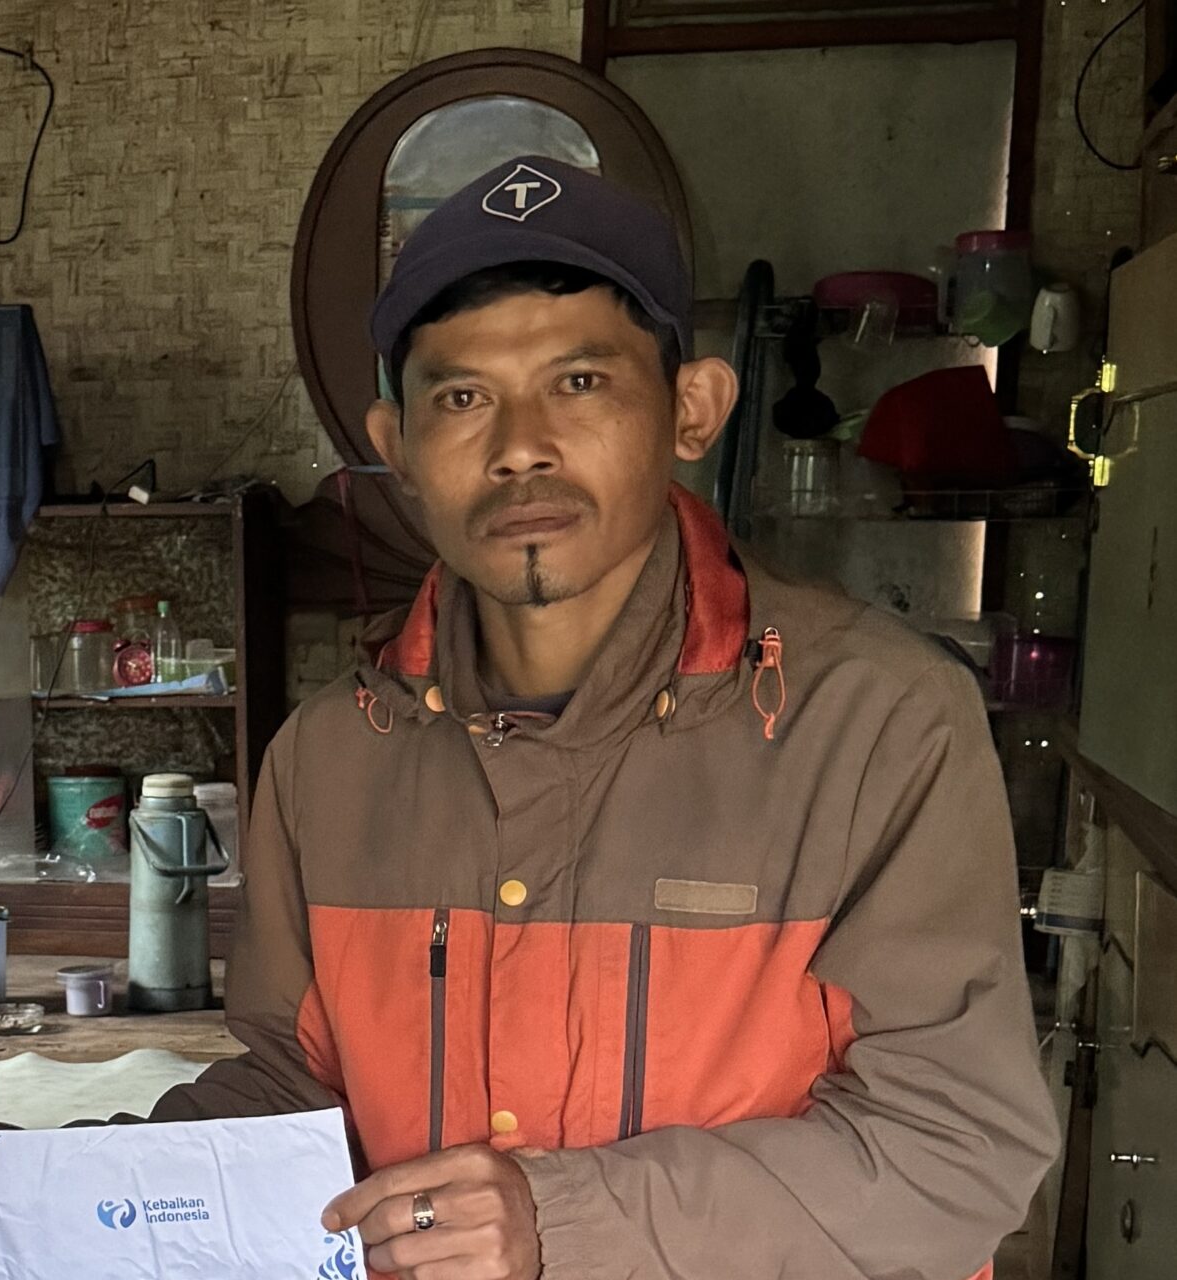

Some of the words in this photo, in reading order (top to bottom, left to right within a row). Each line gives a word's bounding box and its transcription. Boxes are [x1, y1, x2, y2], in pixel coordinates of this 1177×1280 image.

[504, 182, 541, 209] T
[142, 1197, 206, 1211] Kebaikan
[145, 1208, 210, 1224] Indonesia
